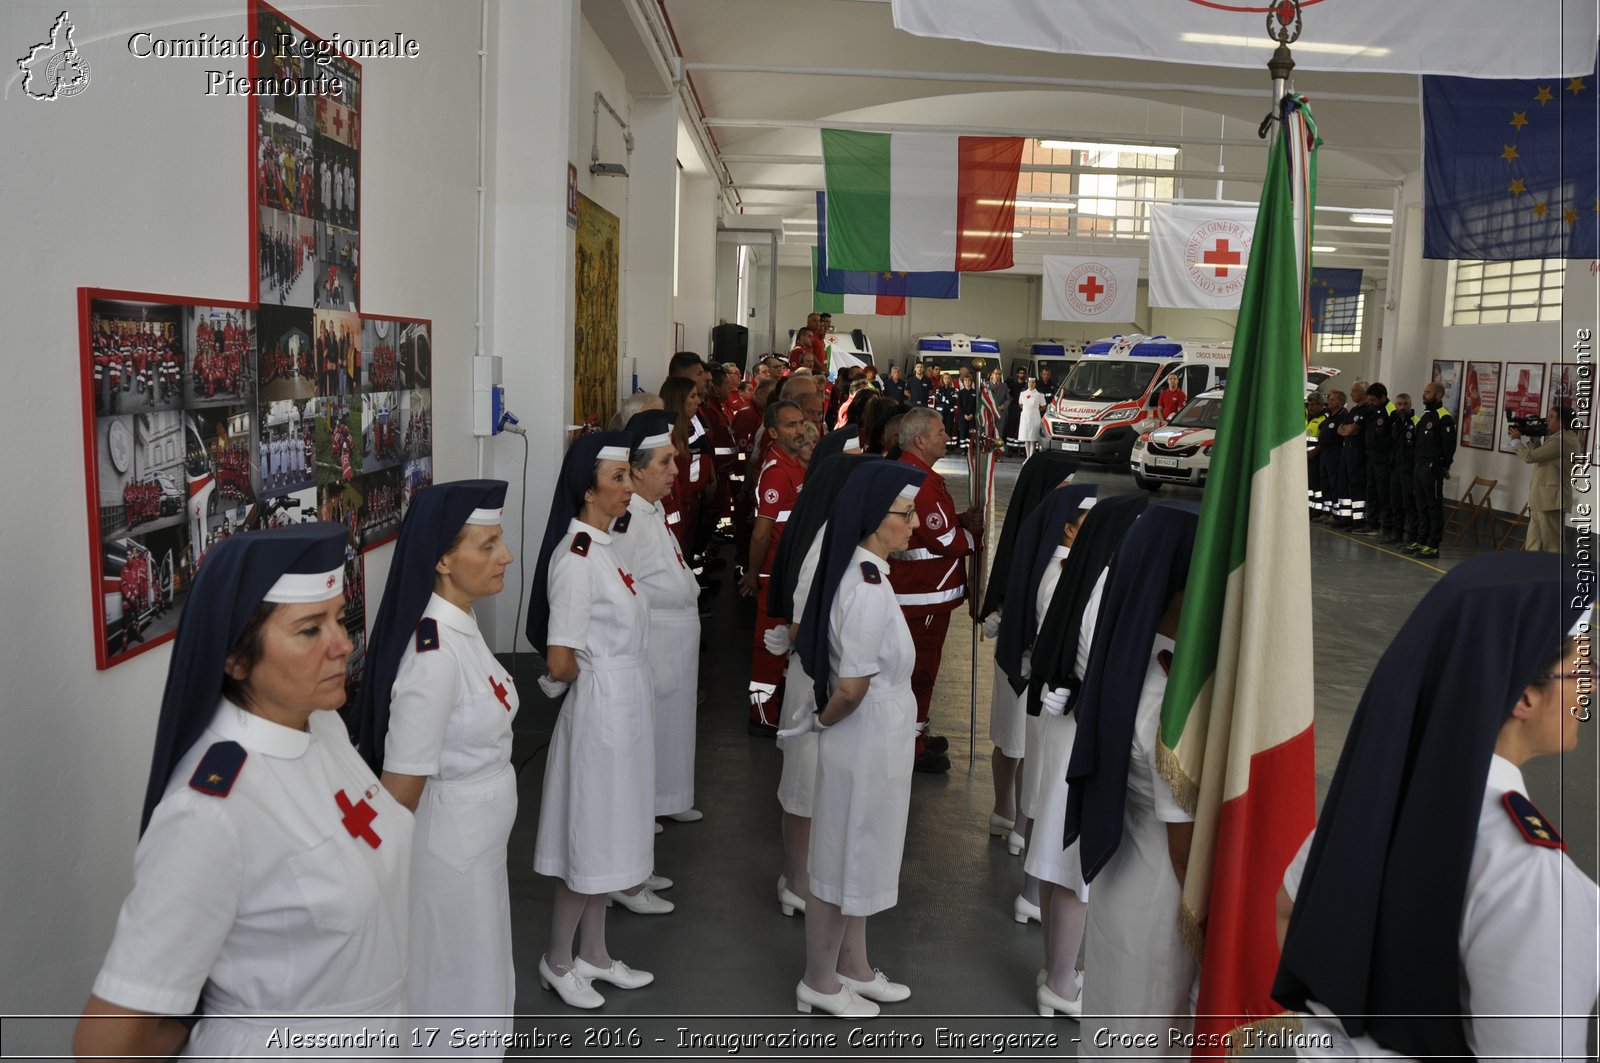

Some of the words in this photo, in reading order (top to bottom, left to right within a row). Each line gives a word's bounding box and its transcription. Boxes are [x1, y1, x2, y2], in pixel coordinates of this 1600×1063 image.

[1197, 225, 1208, 239] DI
[1206, 221, 1245, 239] GINEVRA
[1186, 234, 1216, 293] CONVENZIONE
[1196, 352, 1211, 360] CROCE
[1212, 352, 1226, 360] ROSSA
